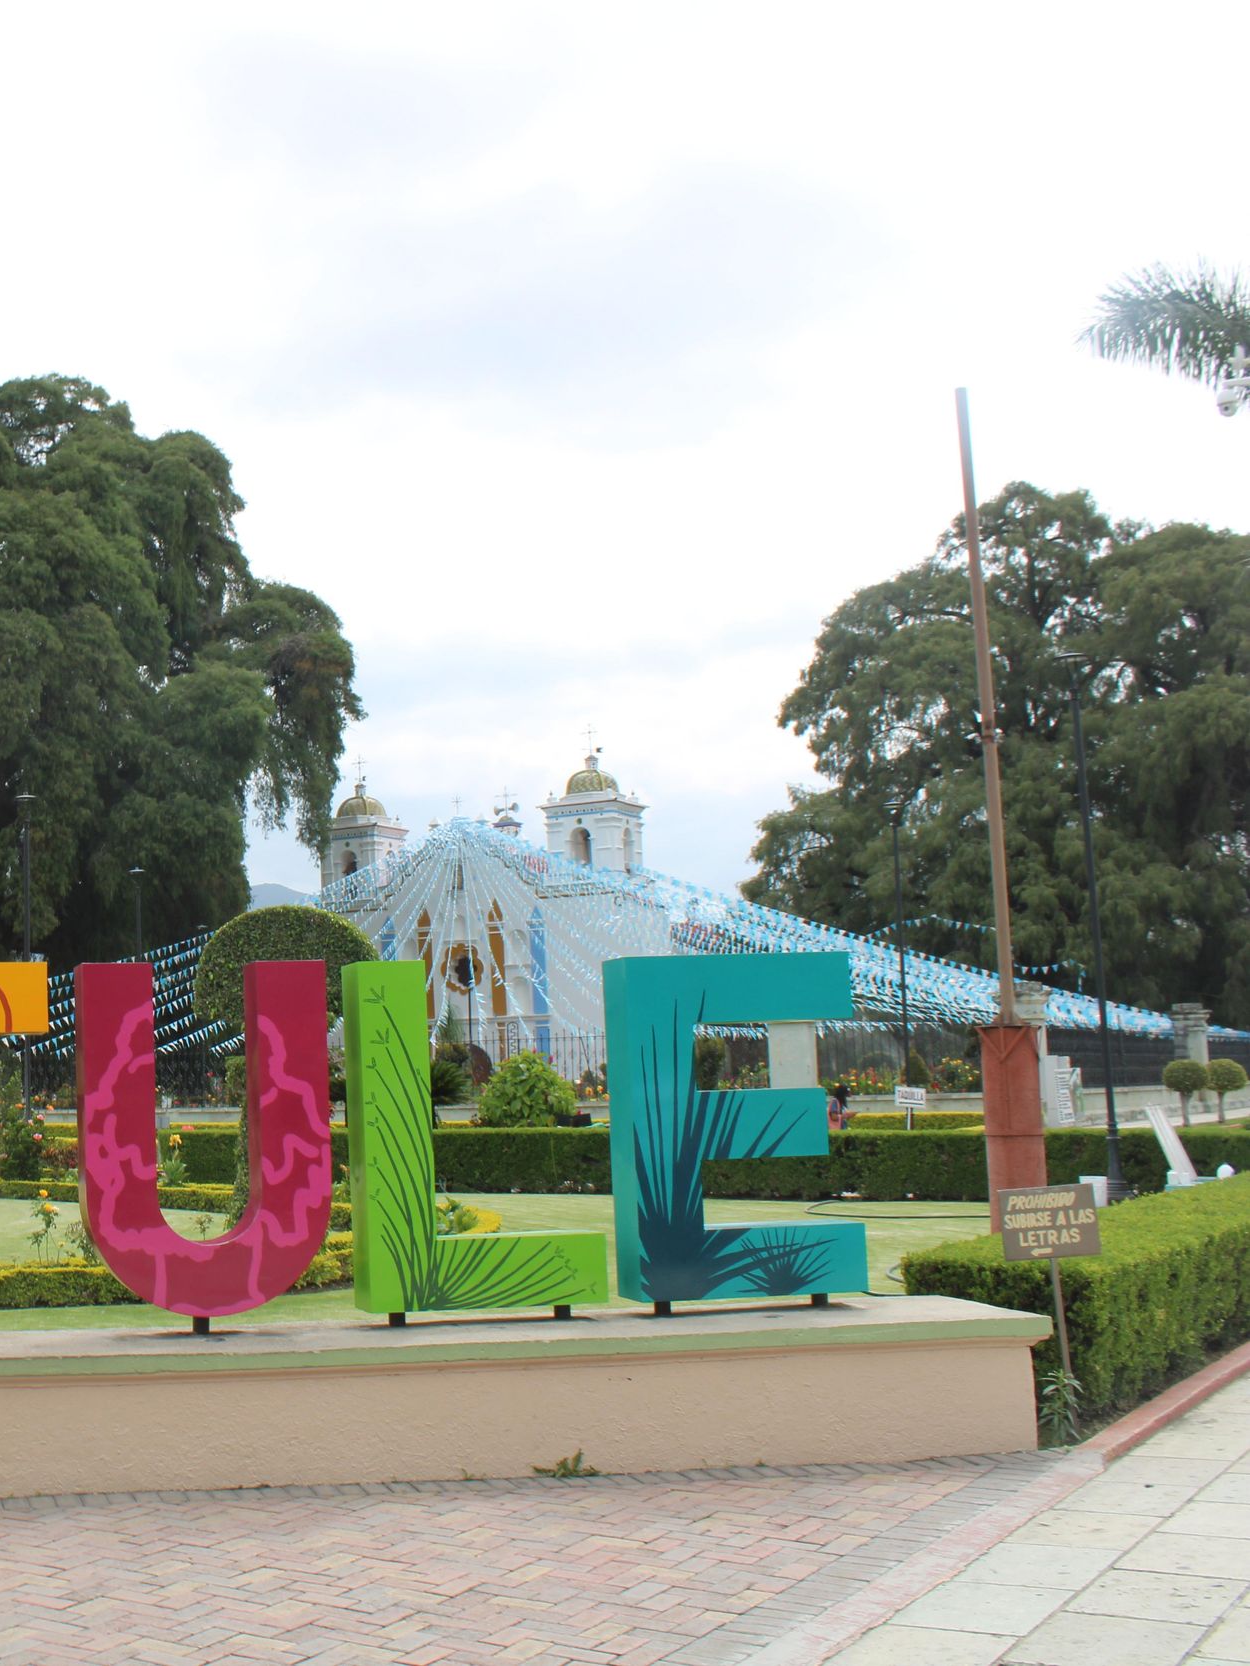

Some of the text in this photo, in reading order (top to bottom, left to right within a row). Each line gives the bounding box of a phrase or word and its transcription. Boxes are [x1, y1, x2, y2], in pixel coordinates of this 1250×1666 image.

[1007, 1191, 1076, 1211] PROHIBIDO
[1004, 1208, 1096, 1229] SUBIRSE A LAS
[1019, 1228, 1081, 1247] LETRAS
